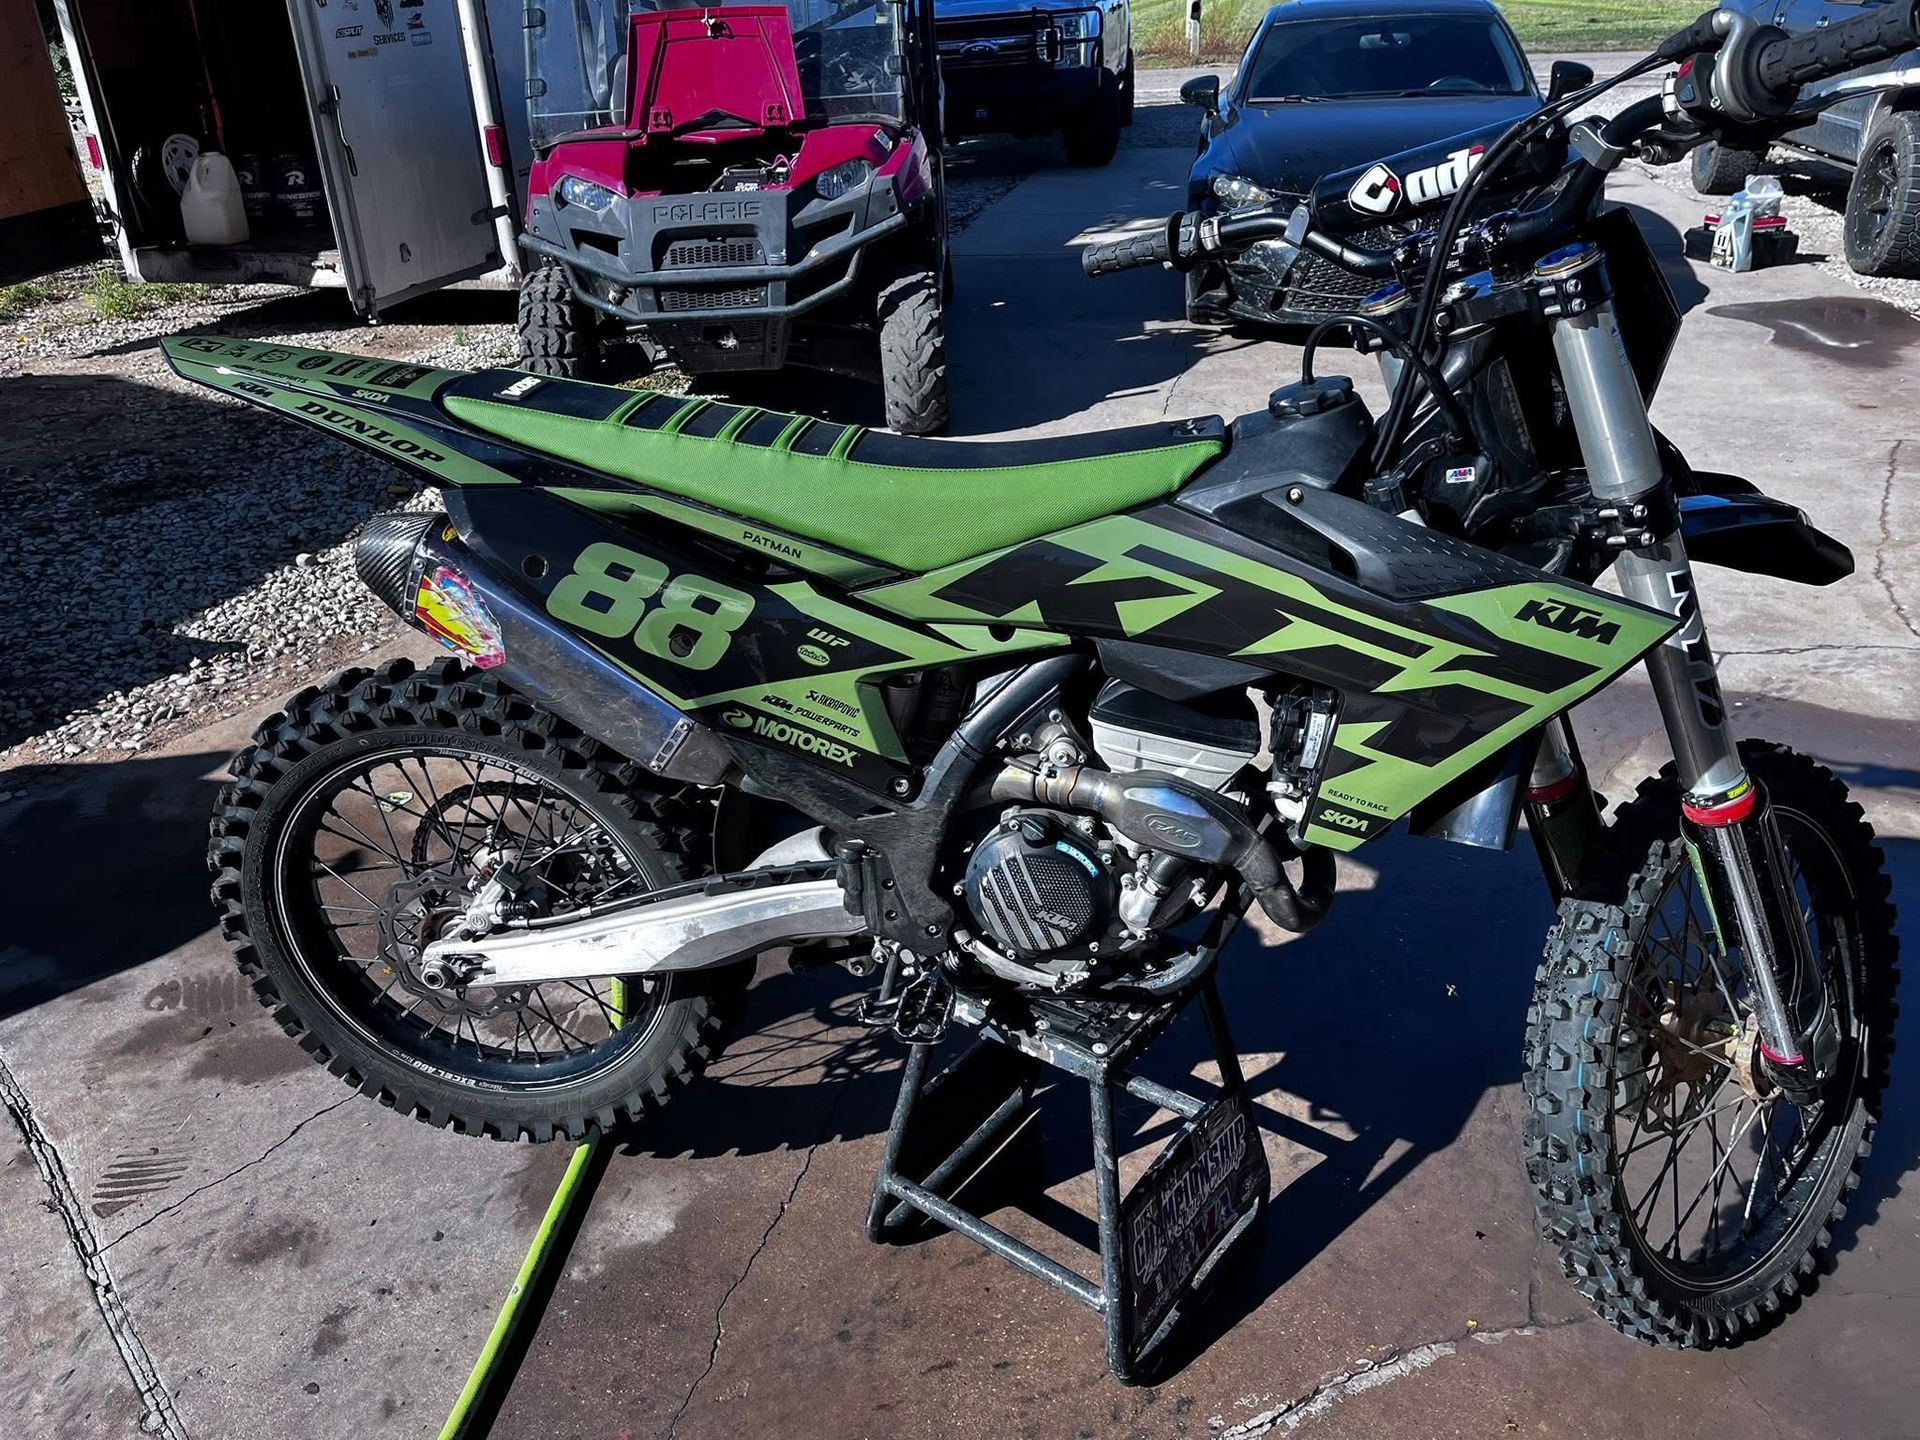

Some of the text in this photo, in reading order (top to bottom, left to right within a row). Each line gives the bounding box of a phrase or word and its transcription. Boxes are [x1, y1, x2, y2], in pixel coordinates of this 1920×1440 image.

[653, 201, 762, 224] POLARIS
[231, 382, 274, 398] KTM
[351, 389, 391, 403] SKDA
[295, 401, 446, 463] DUNLOP
[742, 531, 802, 559] PATMAN
[546, 542, 756, 671] 88
[1514, 597, 1621, 645] KTM
[806, 628, 851, 647] WP
[761, 694, 860, 738] KTM POWERPARTS
[754, 716, 858, 767] MOTOREX
[469, 753, 515, 771] EXCEL
[1327, 788, 1389, 812] READY TO RACE
[1319, 809, 1369, 832] SKDA
[1036, 910, 1079, 931] KTM
